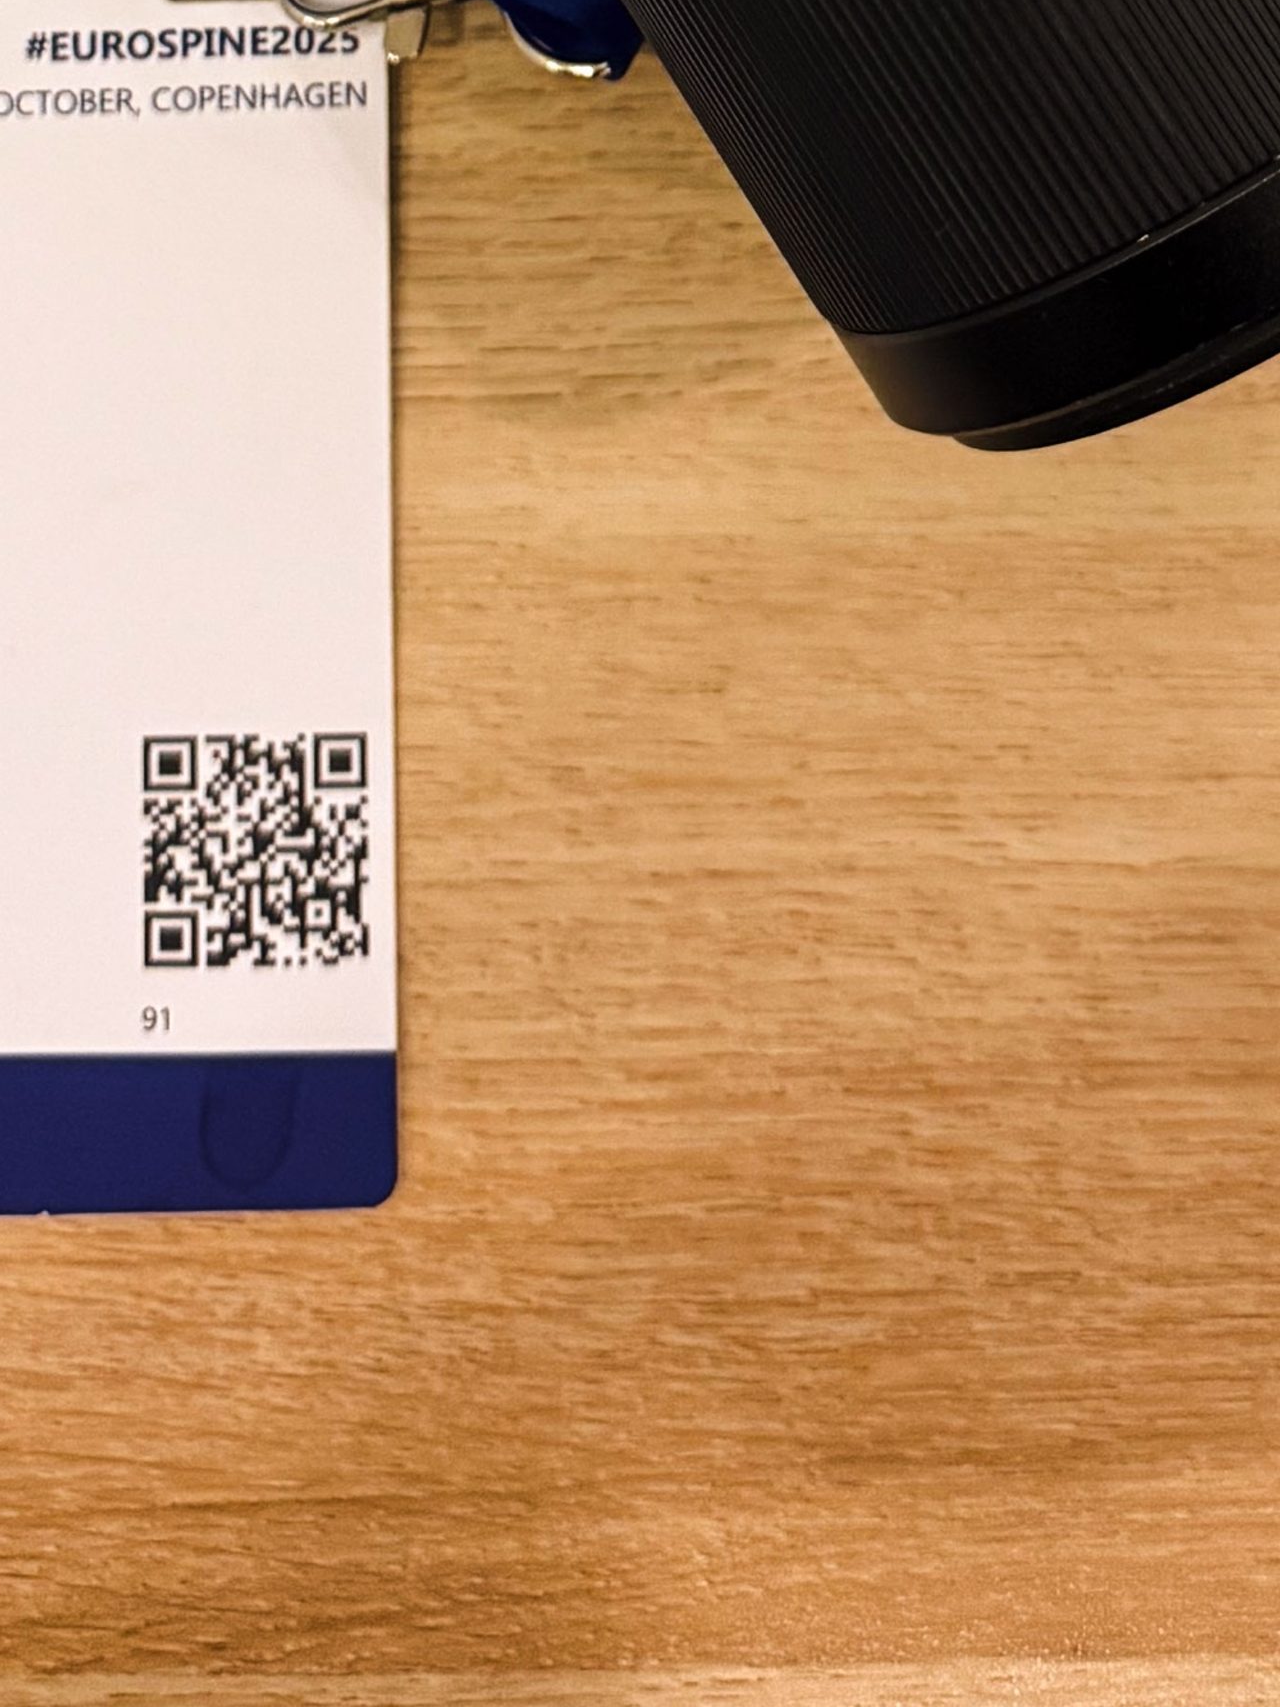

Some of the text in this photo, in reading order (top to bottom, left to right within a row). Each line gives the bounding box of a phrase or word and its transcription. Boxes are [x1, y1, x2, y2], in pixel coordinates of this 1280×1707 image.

[24, 24, 361, 62] #EUROSPINE2025
[151, 80, 368, 115] COPENHAGEN
[140, 1005, 172, 1034] 91
